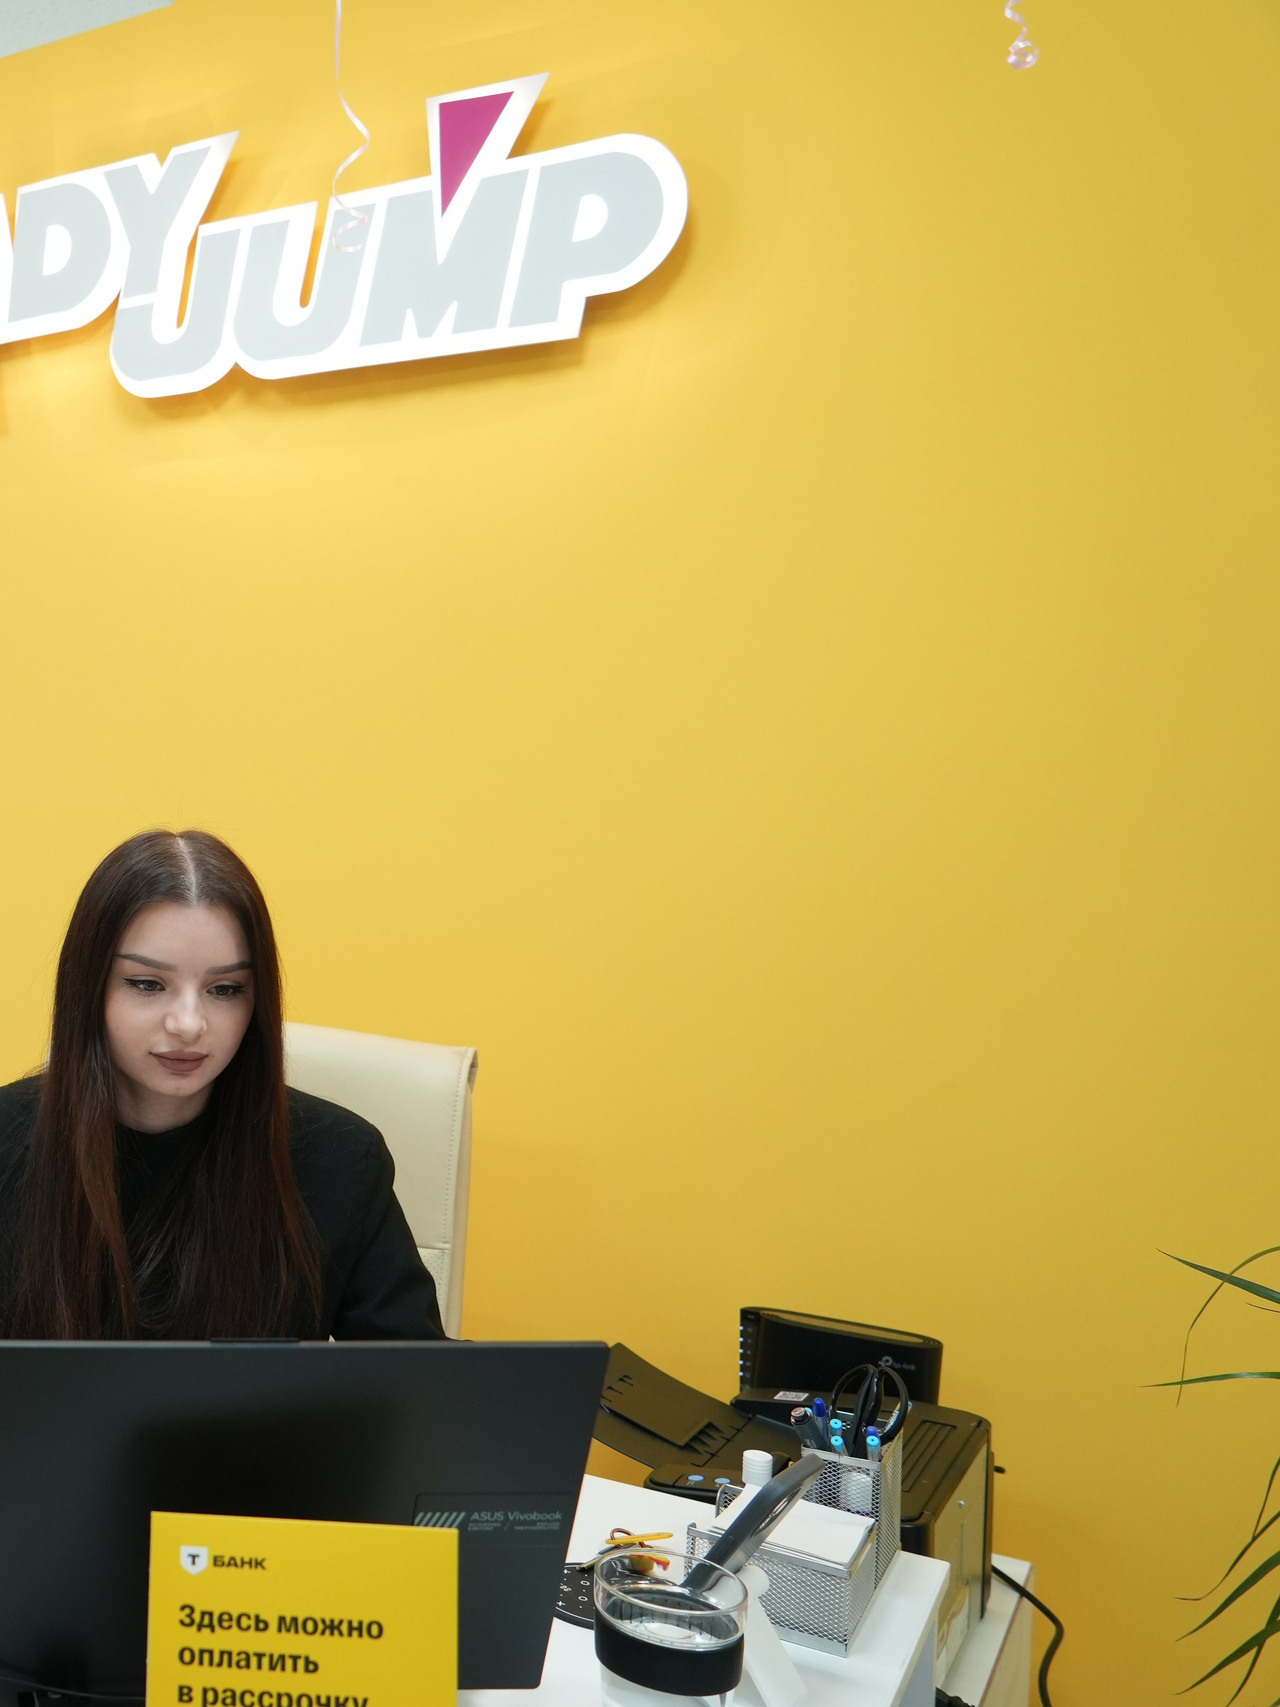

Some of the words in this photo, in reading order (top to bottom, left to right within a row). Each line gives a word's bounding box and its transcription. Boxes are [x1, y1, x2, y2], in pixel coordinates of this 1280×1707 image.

[112, 82, 676, 390] JUMP
[892, 1361, 916, 1371] tp-link
[470, 1511, 504, 1521] ASUS
[508, 1511, 562, 1521] Vivobook
[212, 1555, 267, 1571] БАНК
[179, 1603, 269, 1634] Здесь
[277, 1616, 384, 1640] можно
[178, 1646, 320, 1675] оплатить
[177, 1686, 195, 1704] в
[201, 1685, 369, 1707] рассрочку
